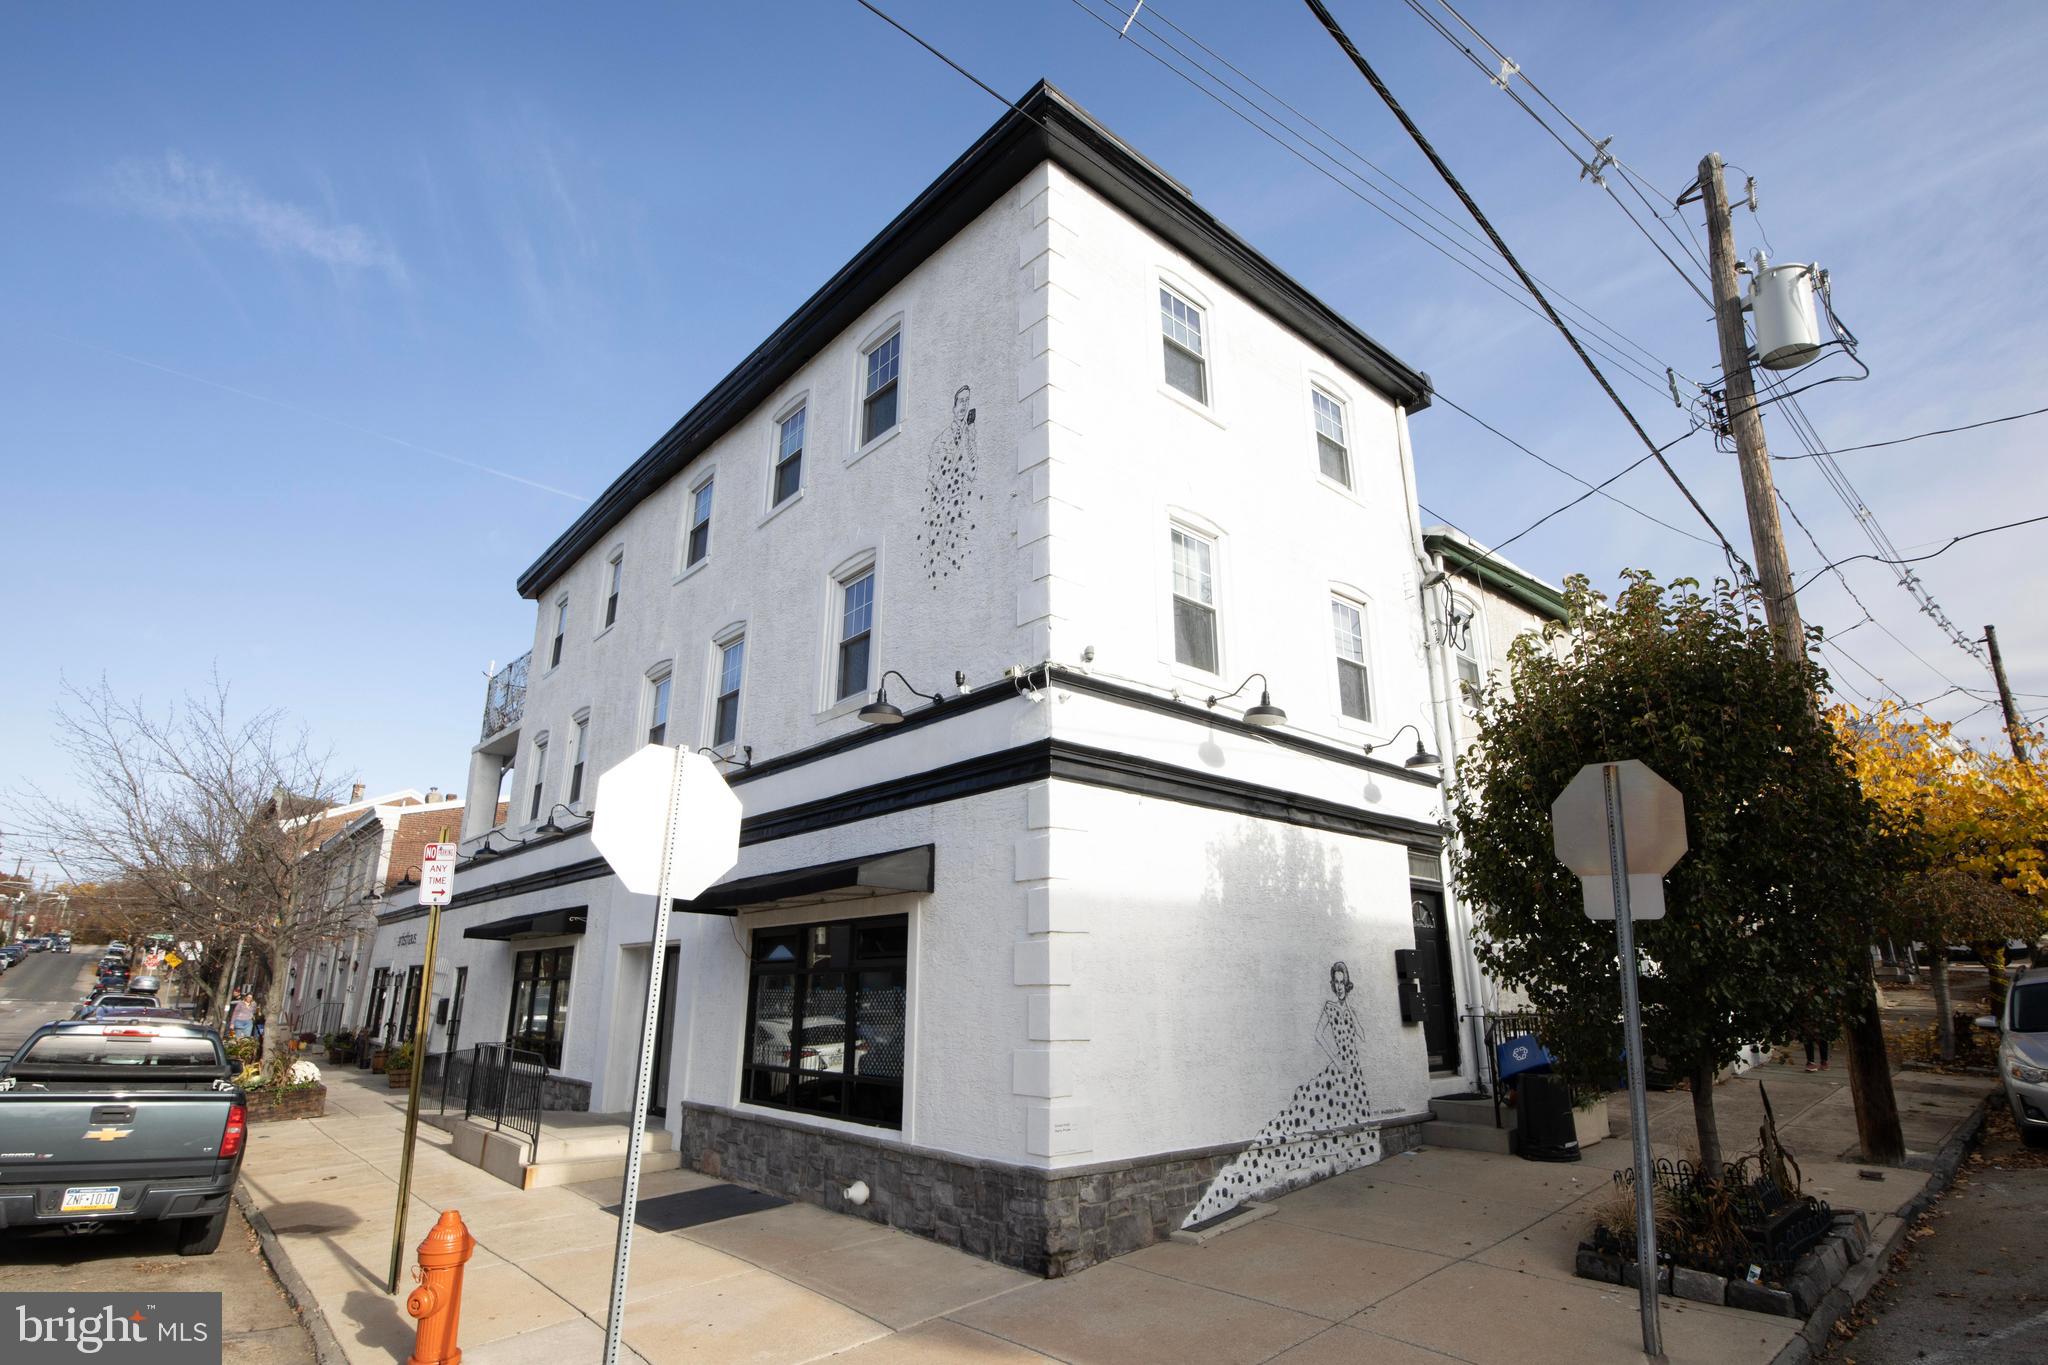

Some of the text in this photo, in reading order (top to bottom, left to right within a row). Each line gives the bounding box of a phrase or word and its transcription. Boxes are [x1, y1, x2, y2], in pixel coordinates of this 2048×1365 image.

[425, 846, 437, 860] NO
[430, 865, 448, 873] ANY
[428, 876, 447, 885] TIME
